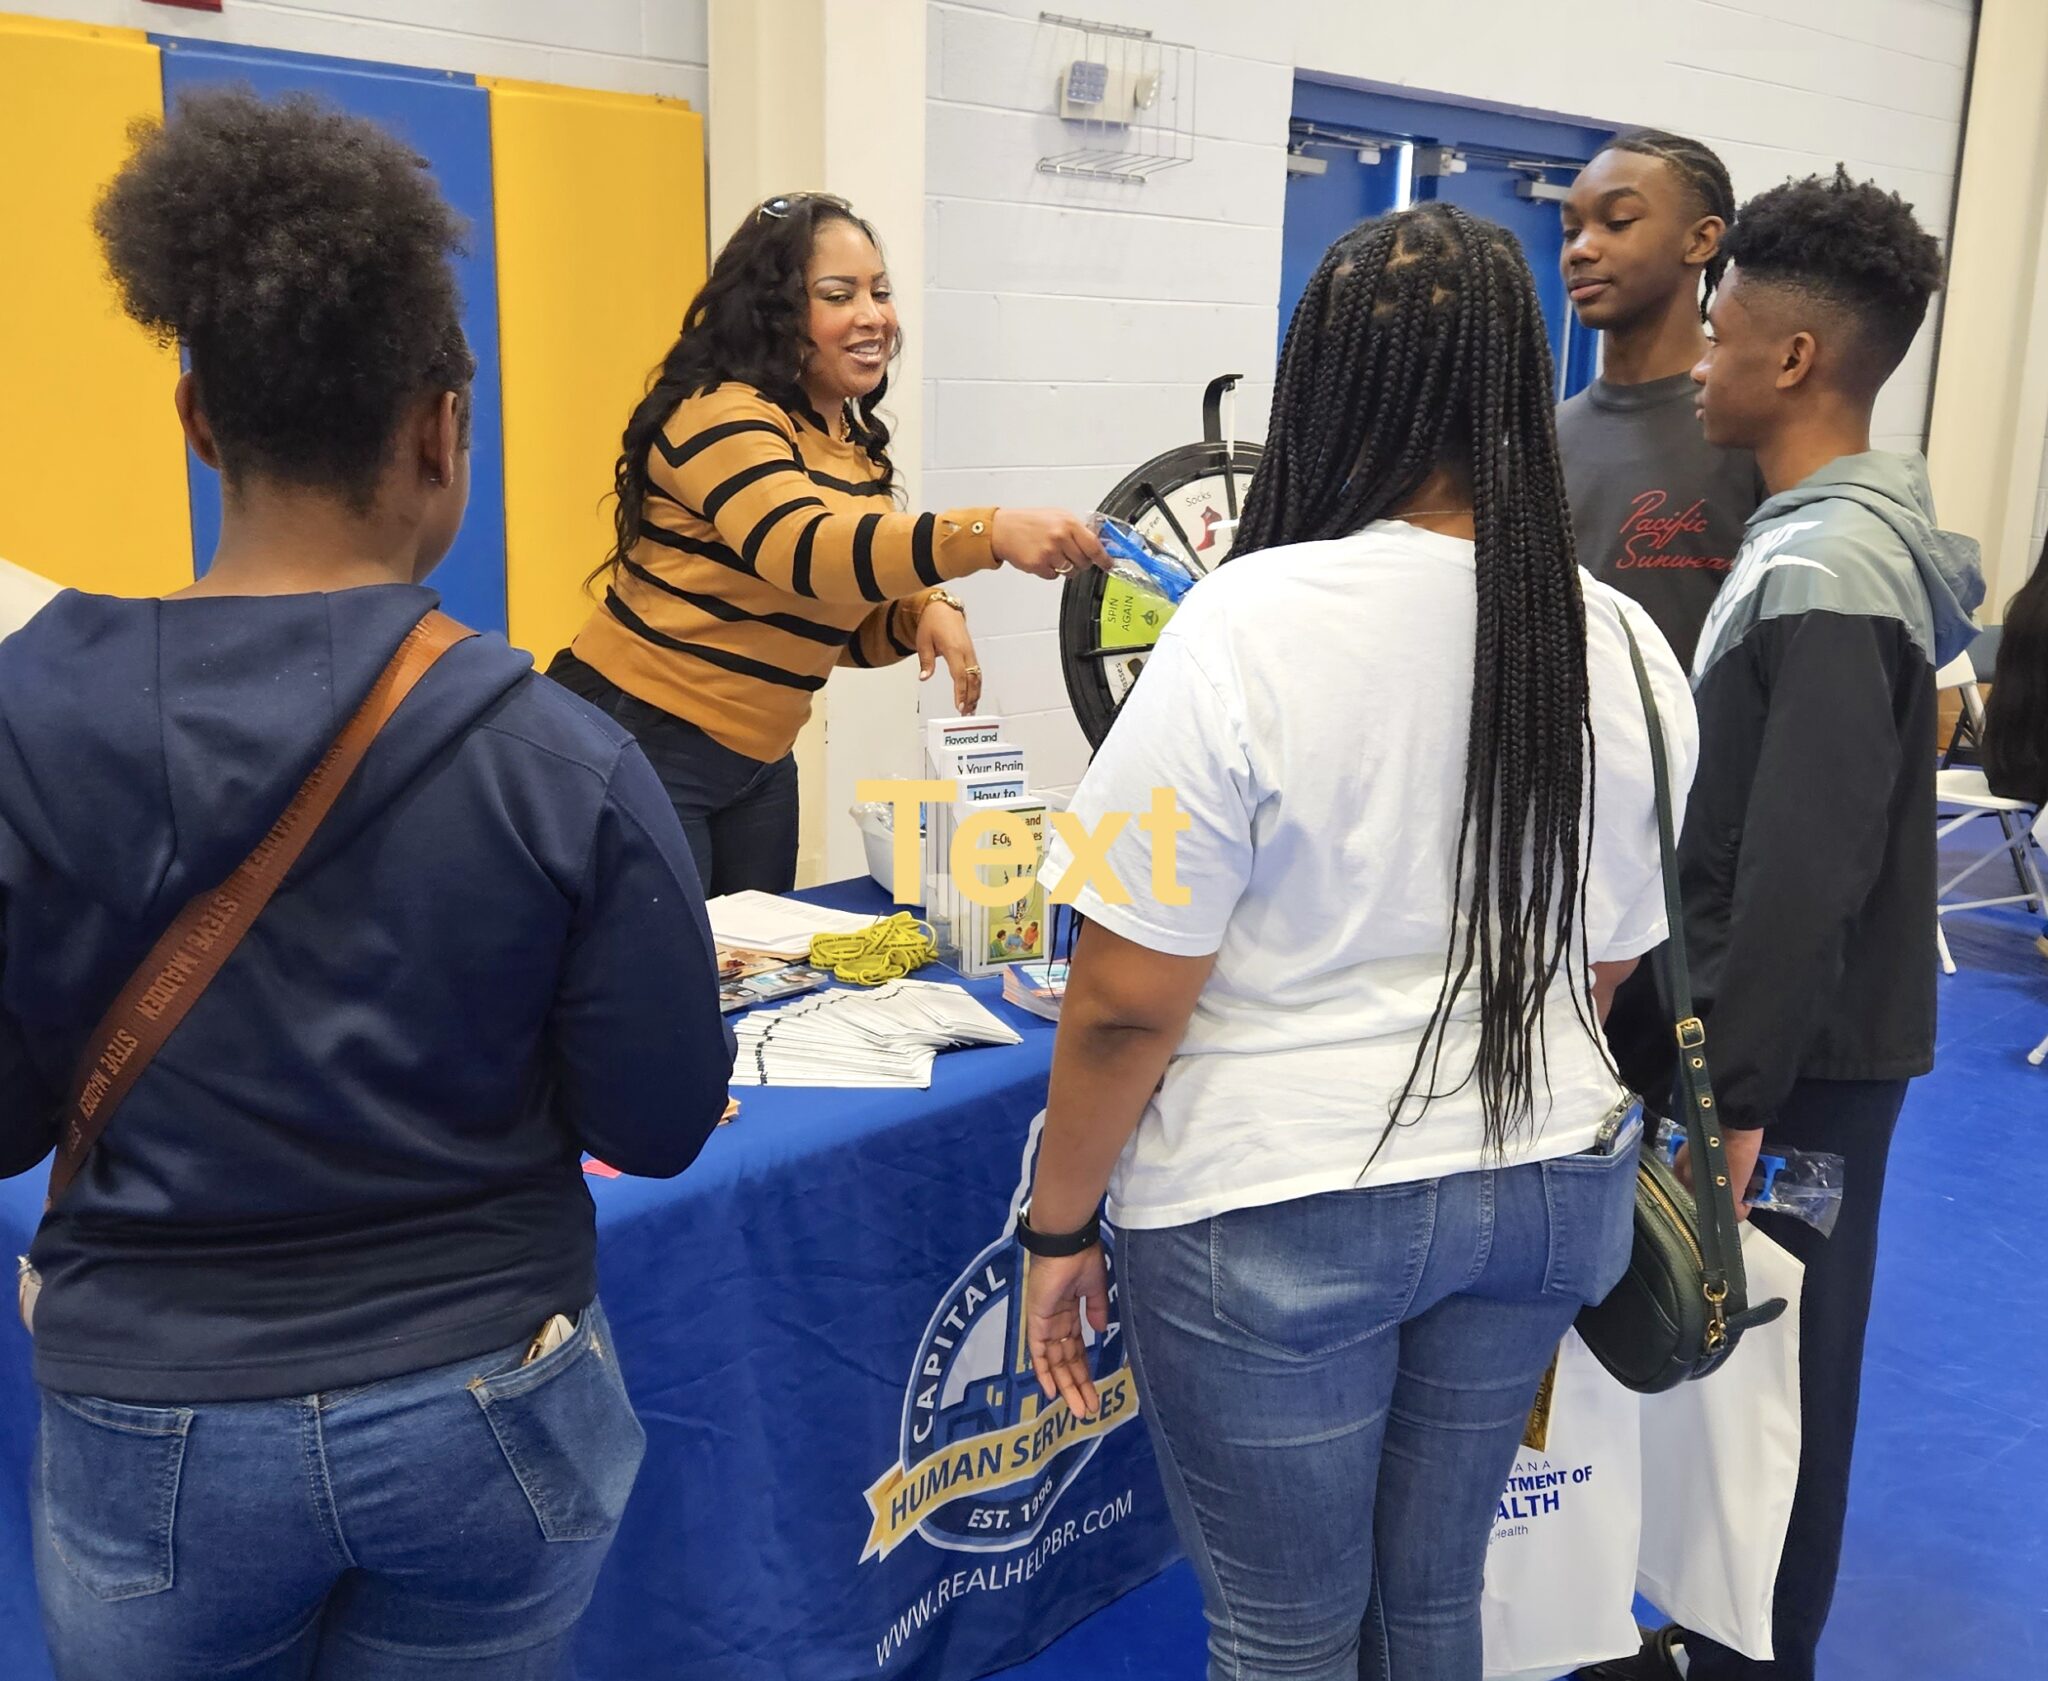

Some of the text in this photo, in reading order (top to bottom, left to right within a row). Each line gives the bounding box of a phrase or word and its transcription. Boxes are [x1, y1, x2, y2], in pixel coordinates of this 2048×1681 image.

[1185, 491, 1212, 507] Socks
[1619, 489, 1708, 549] Pacific
[1107, 597, 1119, 623] SPIN
[1121, 595, 1134, 632] AGAIN
[944, 732, 998, 746] Flavored and
[966, 763, 992, 775] Your
[994, 760, 1024, 772] Brain
[973, 788, 1017, 801] How to
[1024, 813, 1042, 826] and
[135, 946, 201, 1021] MADDEN
[78, 1028, 139, 1121] STEVE MADDEN
[913, 1265, 1007, 1444] CAPITAL
[891, 1443, 1003, 1530] HUMAN
[1508, 1465, 1593, 1493] TMENT OF
[967, 1475, 1053, 1529] EST. 1996
[1496, 1490, 1560, 1524] ALTH
[876, 1489, 1133, 1668] WWW.REALHELPBR.COM
